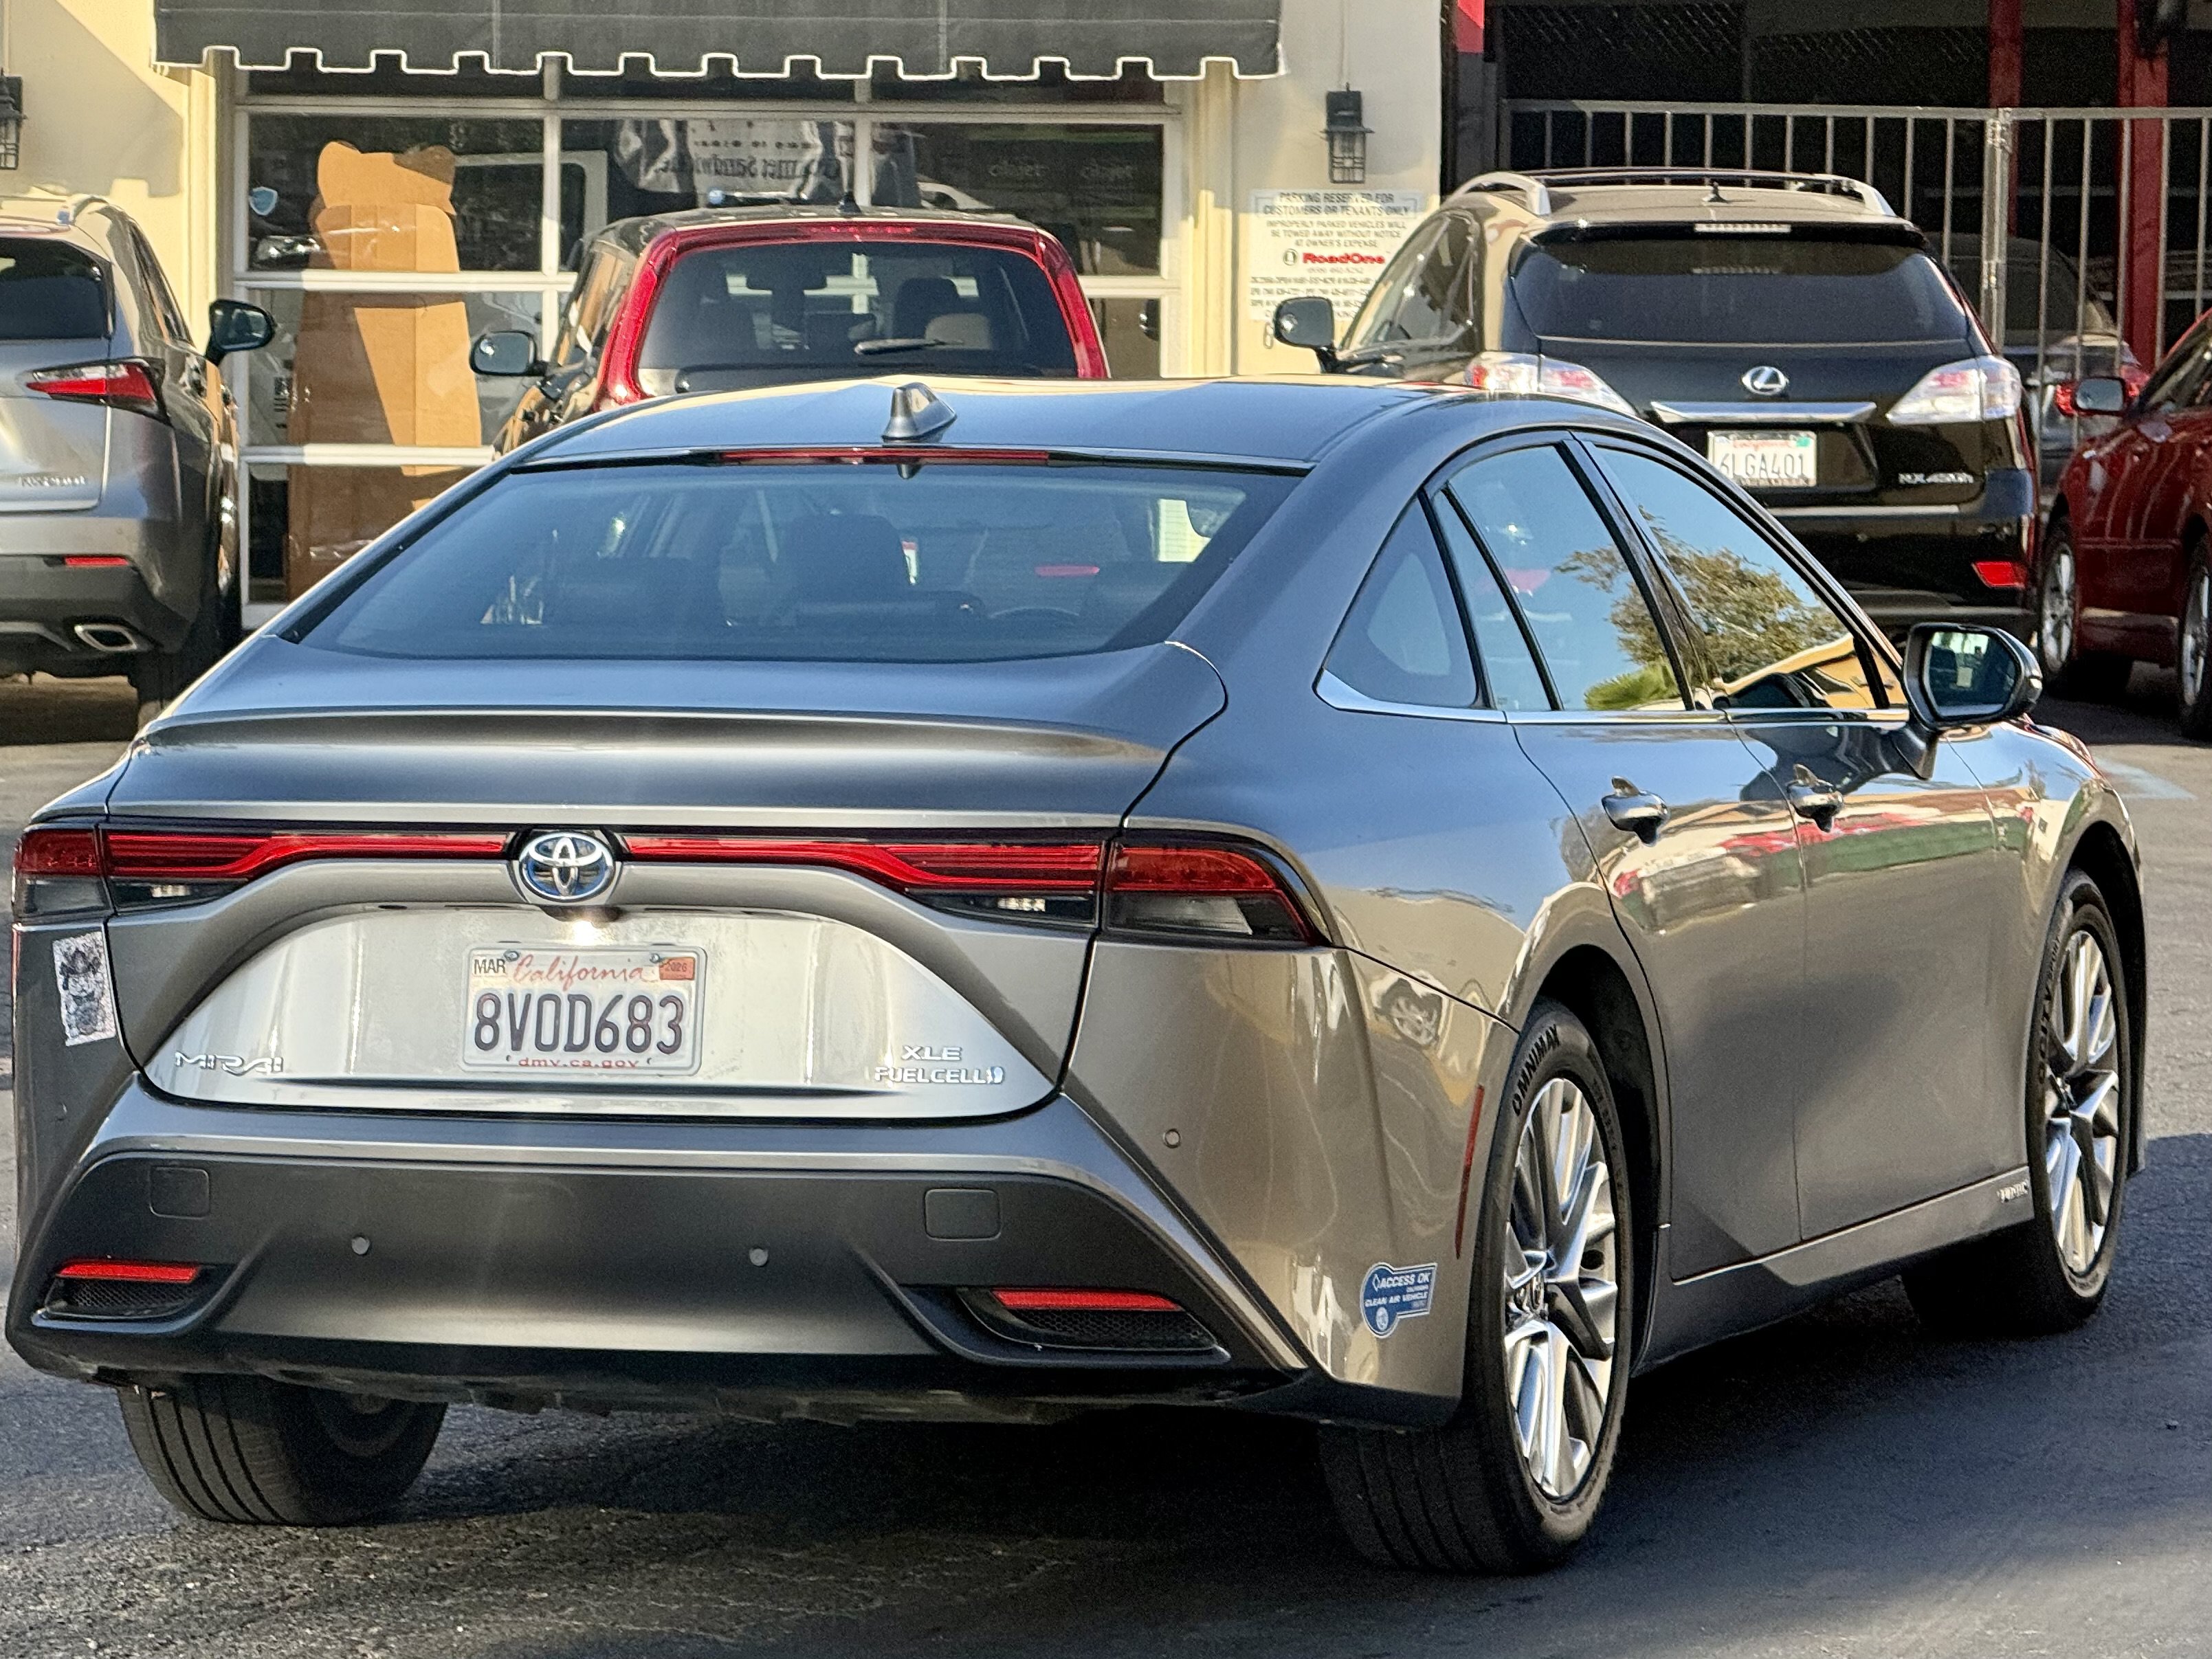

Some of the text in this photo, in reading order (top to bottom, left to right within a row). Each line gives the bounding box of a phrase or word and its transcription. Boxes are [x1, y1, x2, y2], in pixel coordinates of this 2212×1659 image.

[1279, 192, 1395, 203] PARKING RESERVED FOR
[1263, 205, 1322, 215] CUSTOMERS
[1324, 205, 1338, 215] OR
[1340, 205, 1383, 216] TENANTS
[1302, 252, 1385, 265] RoadOne
[473, 958, 507, 975] MAR
[513, 953, 645, 992] California
[474, 992, 684, 1055] 8VOD683
[901, 1045, 962, 1061] XLE
[174, 1049, 284, 1077] MIRAI
[518, 1056, 640, 1069] dmv.ca.gov
[1512, 1023, 1561, 1117] OMNIMAX
[1378, 1273, 1416, 1289] ACCESS
[1416, 1271, 1432, 1284] OK
[1364, 1296, 1388, 1307] CLEAN
